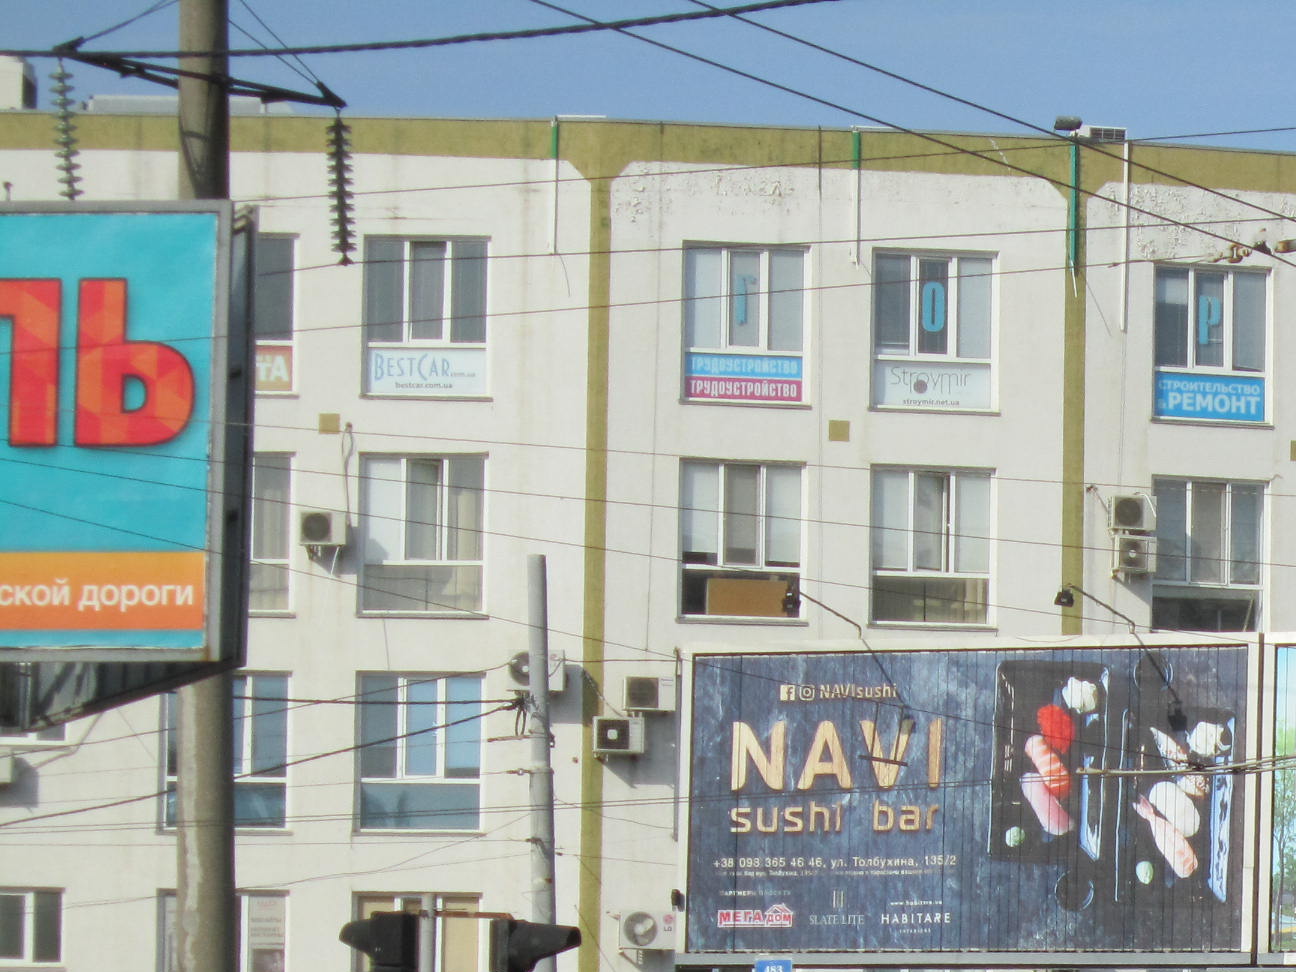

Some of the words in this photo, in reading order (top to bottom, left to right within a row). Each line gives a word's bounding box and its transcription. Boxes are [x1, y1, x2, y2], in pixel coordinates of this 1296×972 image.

[691, 355, 798, 376] ТРУДОУСТРОЙСТВО
[690, 378, 798, 398] ТРУДОУСТРОЙСТВО
[890, 366, 972, 394] Stroymir
[1159, 379, 1261, 396] СТРОИТЕЛЬСТВО
[1168, 391, 1261, 415] РЕМОНТ
[0, 578, 70, 606] ской
[78, 585, 194, 612] дороги
[820, 683, 898, 698] NAVIsushi
[731, 717, 943, 791] NAVI
[730, 800, 844, 833] sushi
[872, 800, 940, 832] bar
[713, 858, 734, 868] +38
[765, 857, 786, 868] 365
[853, 856, 919, 868] Толбухина,
[924, 855, 957, 866] 135/2
[719, 911, 764, 925] МЕГА
[881, 912, 952, 925] HABITARE
